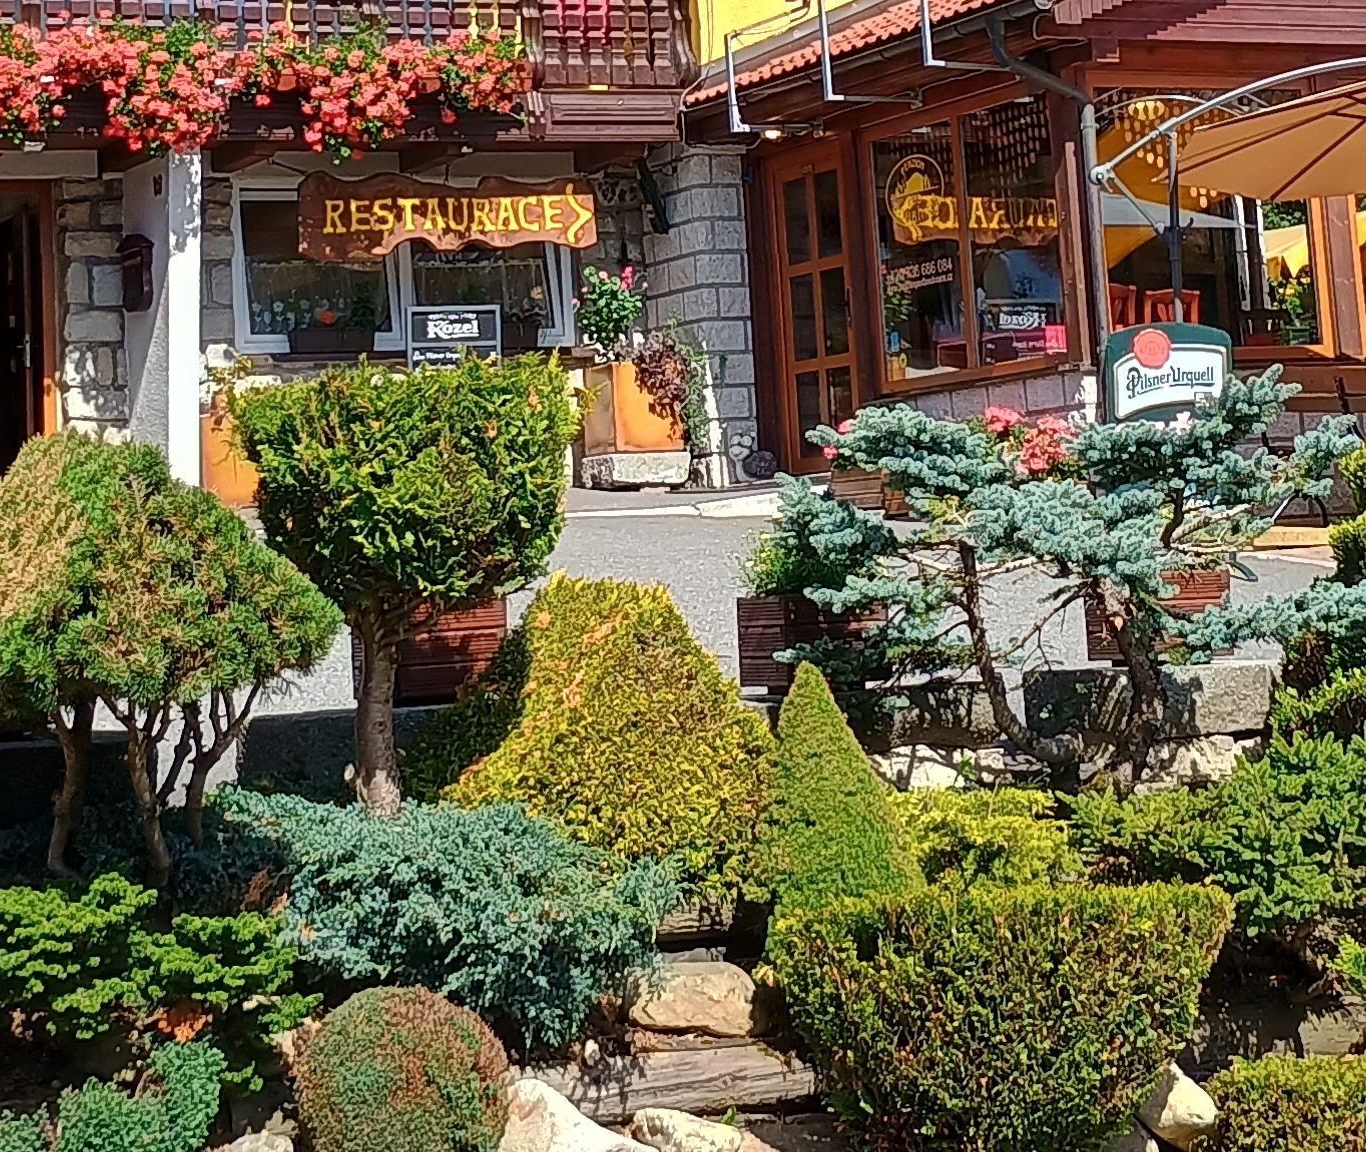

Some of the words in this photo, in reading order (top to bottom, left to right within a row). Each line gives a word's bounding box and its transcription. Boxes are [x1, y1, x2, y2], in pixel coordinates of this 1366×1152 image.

[323, 194, 565, 234] RESTAURACE
[937, 256, 953, 273] 084
[426, 320, 479, 339] Kozel
[1125, 366, 1172, 399] Pilsner
[1169, 365, 1215, 389] Urquell
